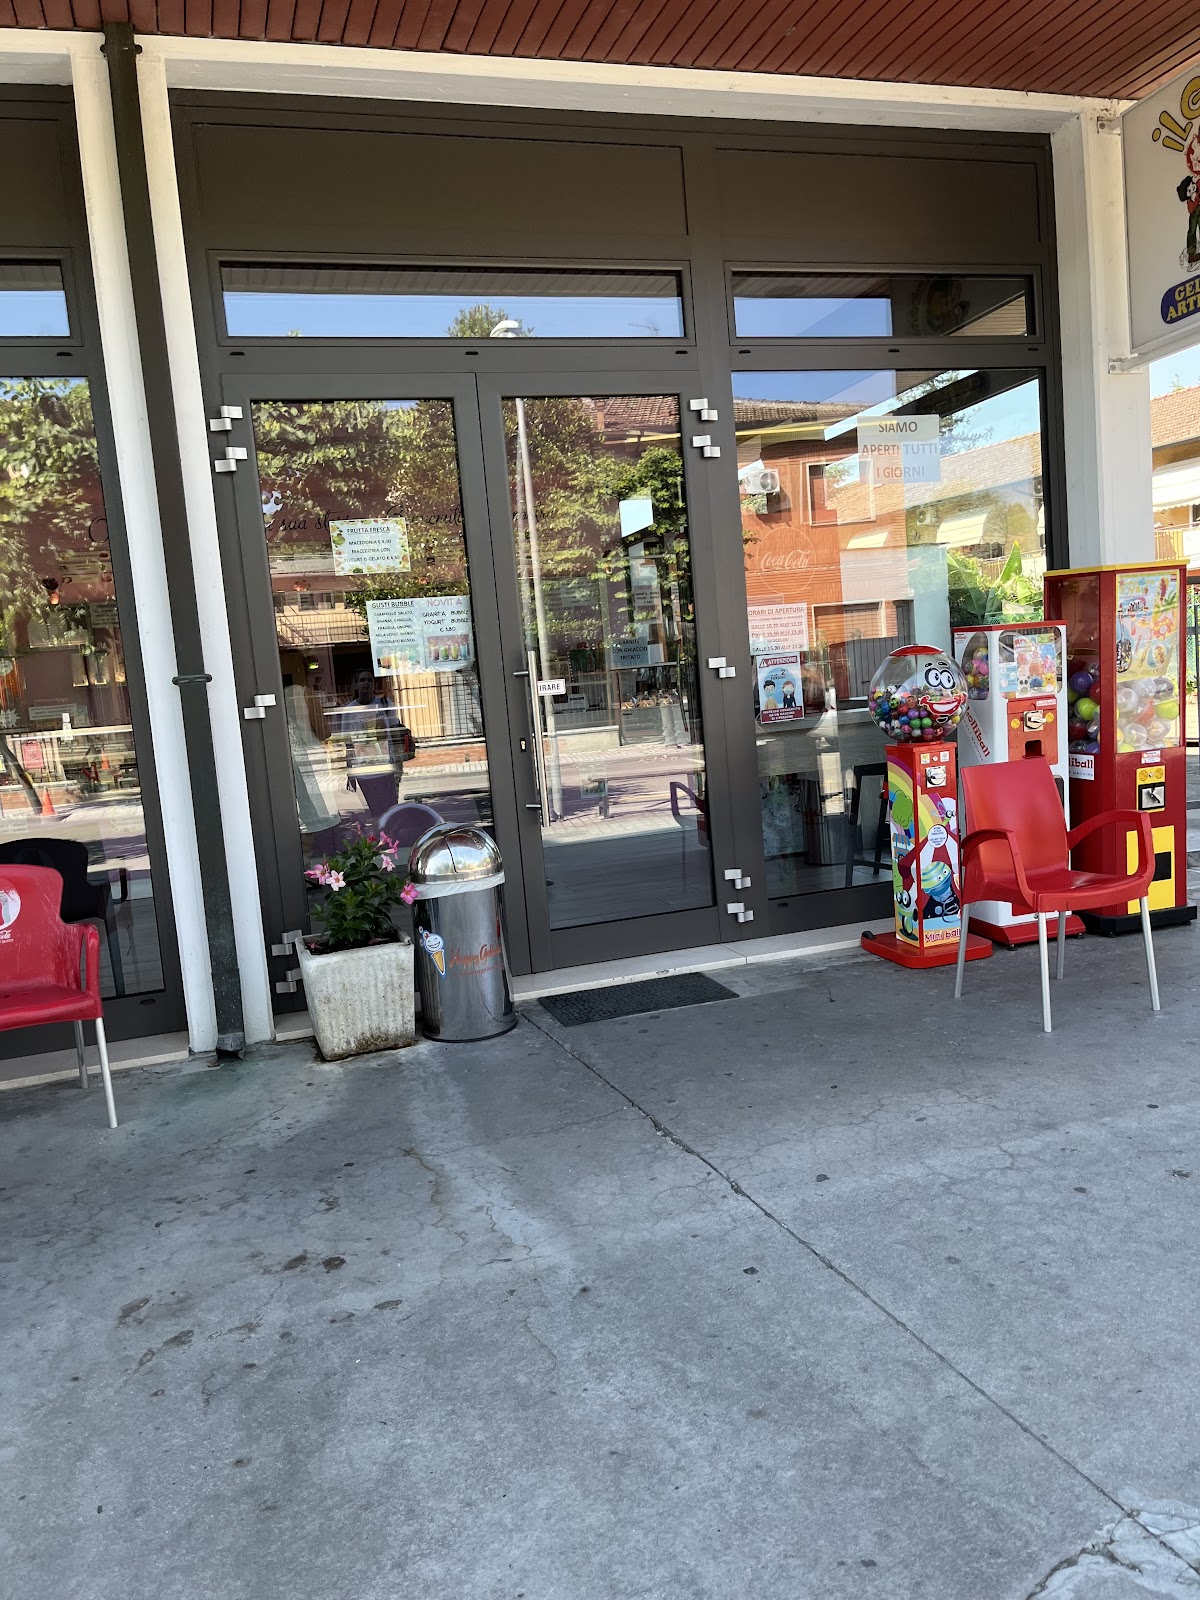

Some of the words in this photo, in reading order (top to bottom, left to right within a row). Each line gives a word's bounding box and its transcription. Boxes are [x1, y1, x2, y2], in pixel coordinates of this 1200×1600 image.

[878, 421, 918, 433] SIAMO
[861, 444, 901, 456] APERTI
[902, 443, 938, 455] TUTTI
[876, 467, 880, 479] I
[882, 466, 925, 478] GIORNI
[767, 656, 797, 665] ATTENZIONE
[538, 684, 560, 692] IRARE
[925, 932, 944, 942] Mini
[945, 928, 961, 940] ball
